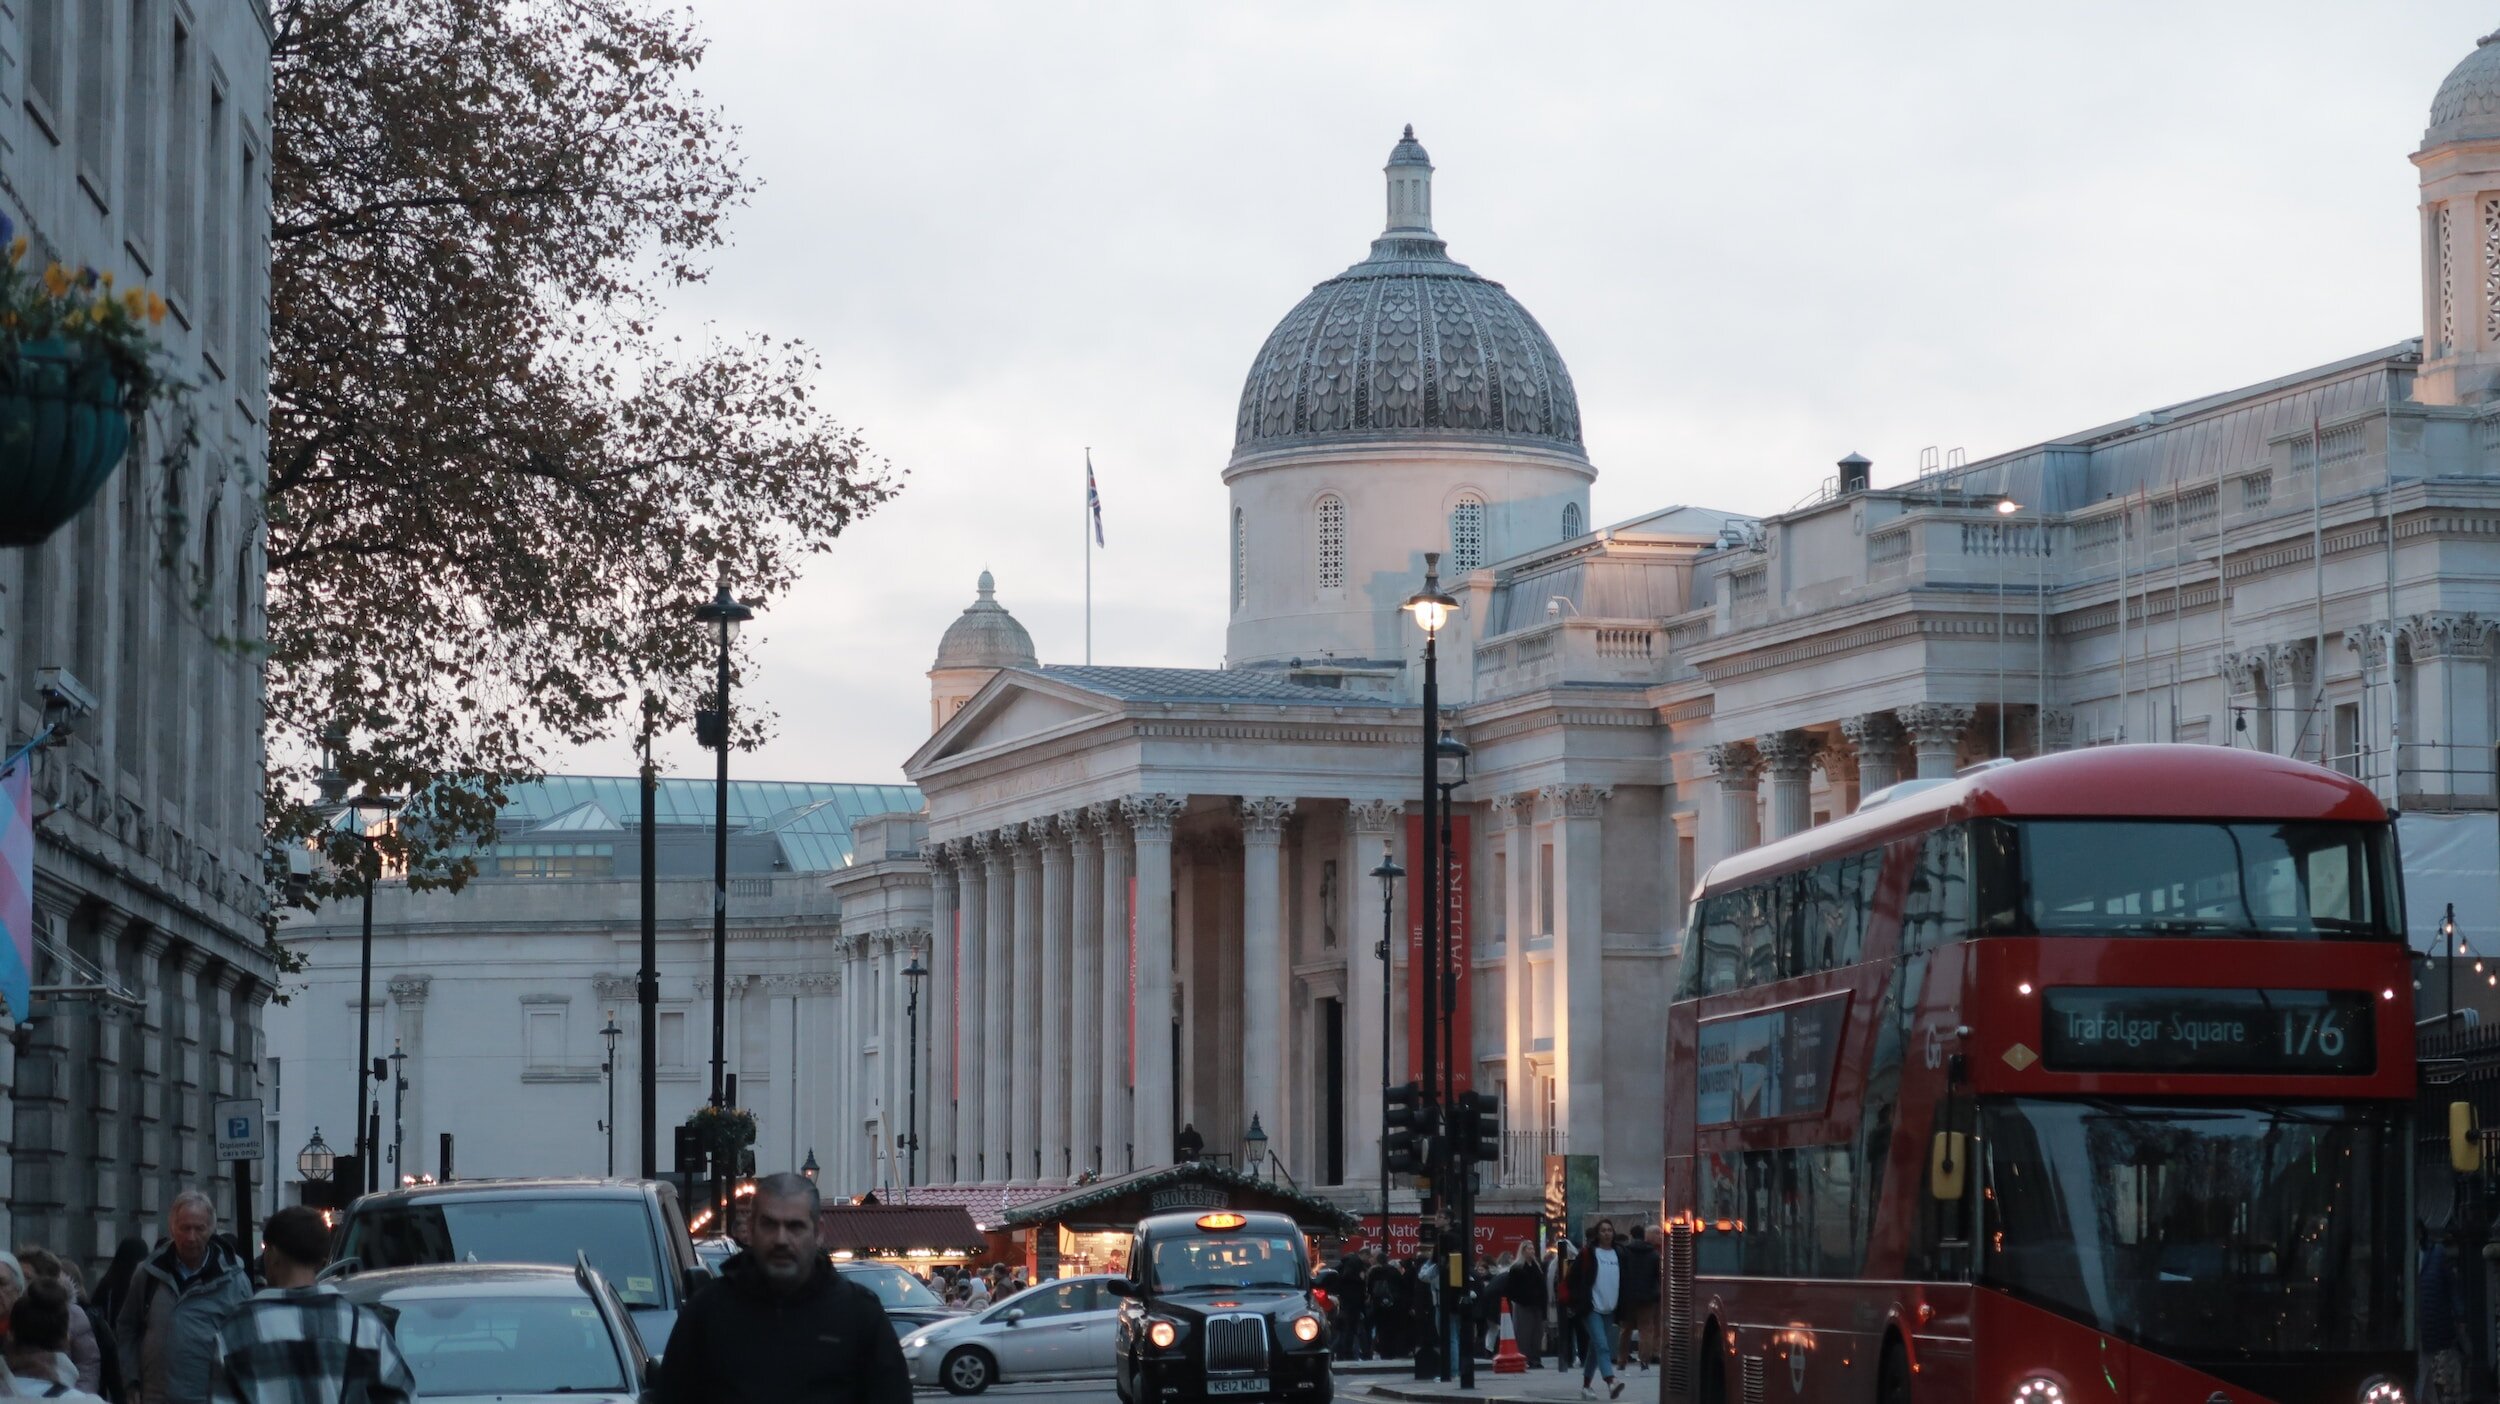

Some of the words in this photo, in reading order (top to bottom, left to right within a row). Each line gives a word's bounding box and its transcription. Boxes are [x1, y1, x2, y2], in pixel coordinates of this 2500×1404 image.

[1450, 862, 1463, 981] GALLERY
[1414, 924, 1423, 948] THE
[2067, 1010, 2161, 1047] Trafalgar
[2171, 1012, 2244, 1050] Square
[2284, 1009, 2344, 1056] 176
[219, 1141, 260, 1149] Diplomatic
[1152, 1190, 1229, 1208] SMOKESHED
[1214, 1381, 1238, 1392] KE12
